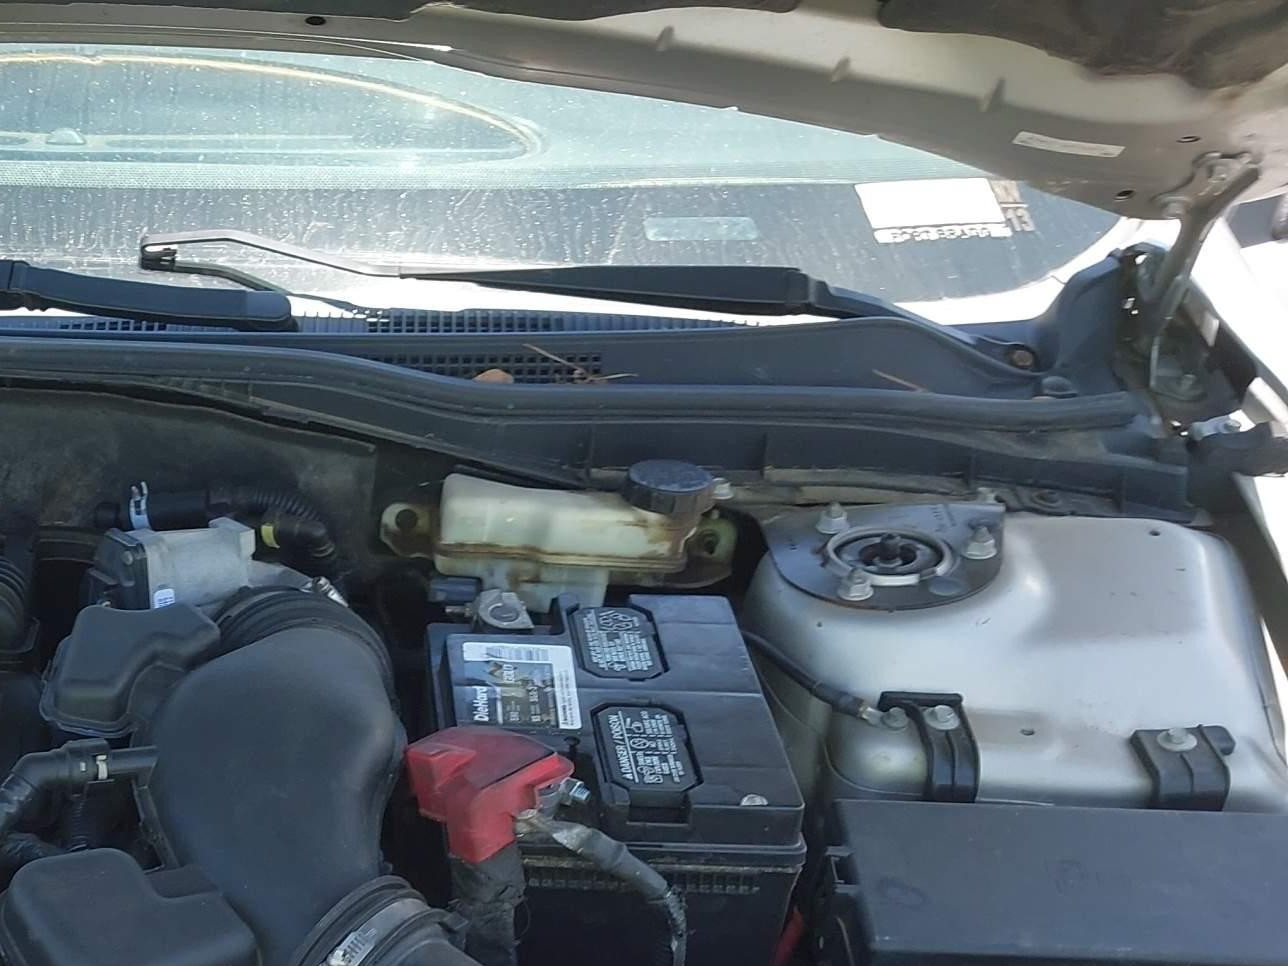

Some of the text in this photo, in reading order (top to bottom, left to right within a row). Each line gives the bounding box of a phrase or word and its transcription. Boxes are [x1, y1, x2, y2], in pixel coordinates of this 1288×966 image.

[472, 686, 489, 722] DieHard
[608, 714, 625, 739] POISON
[615, 745, 633, 773] DANGER
